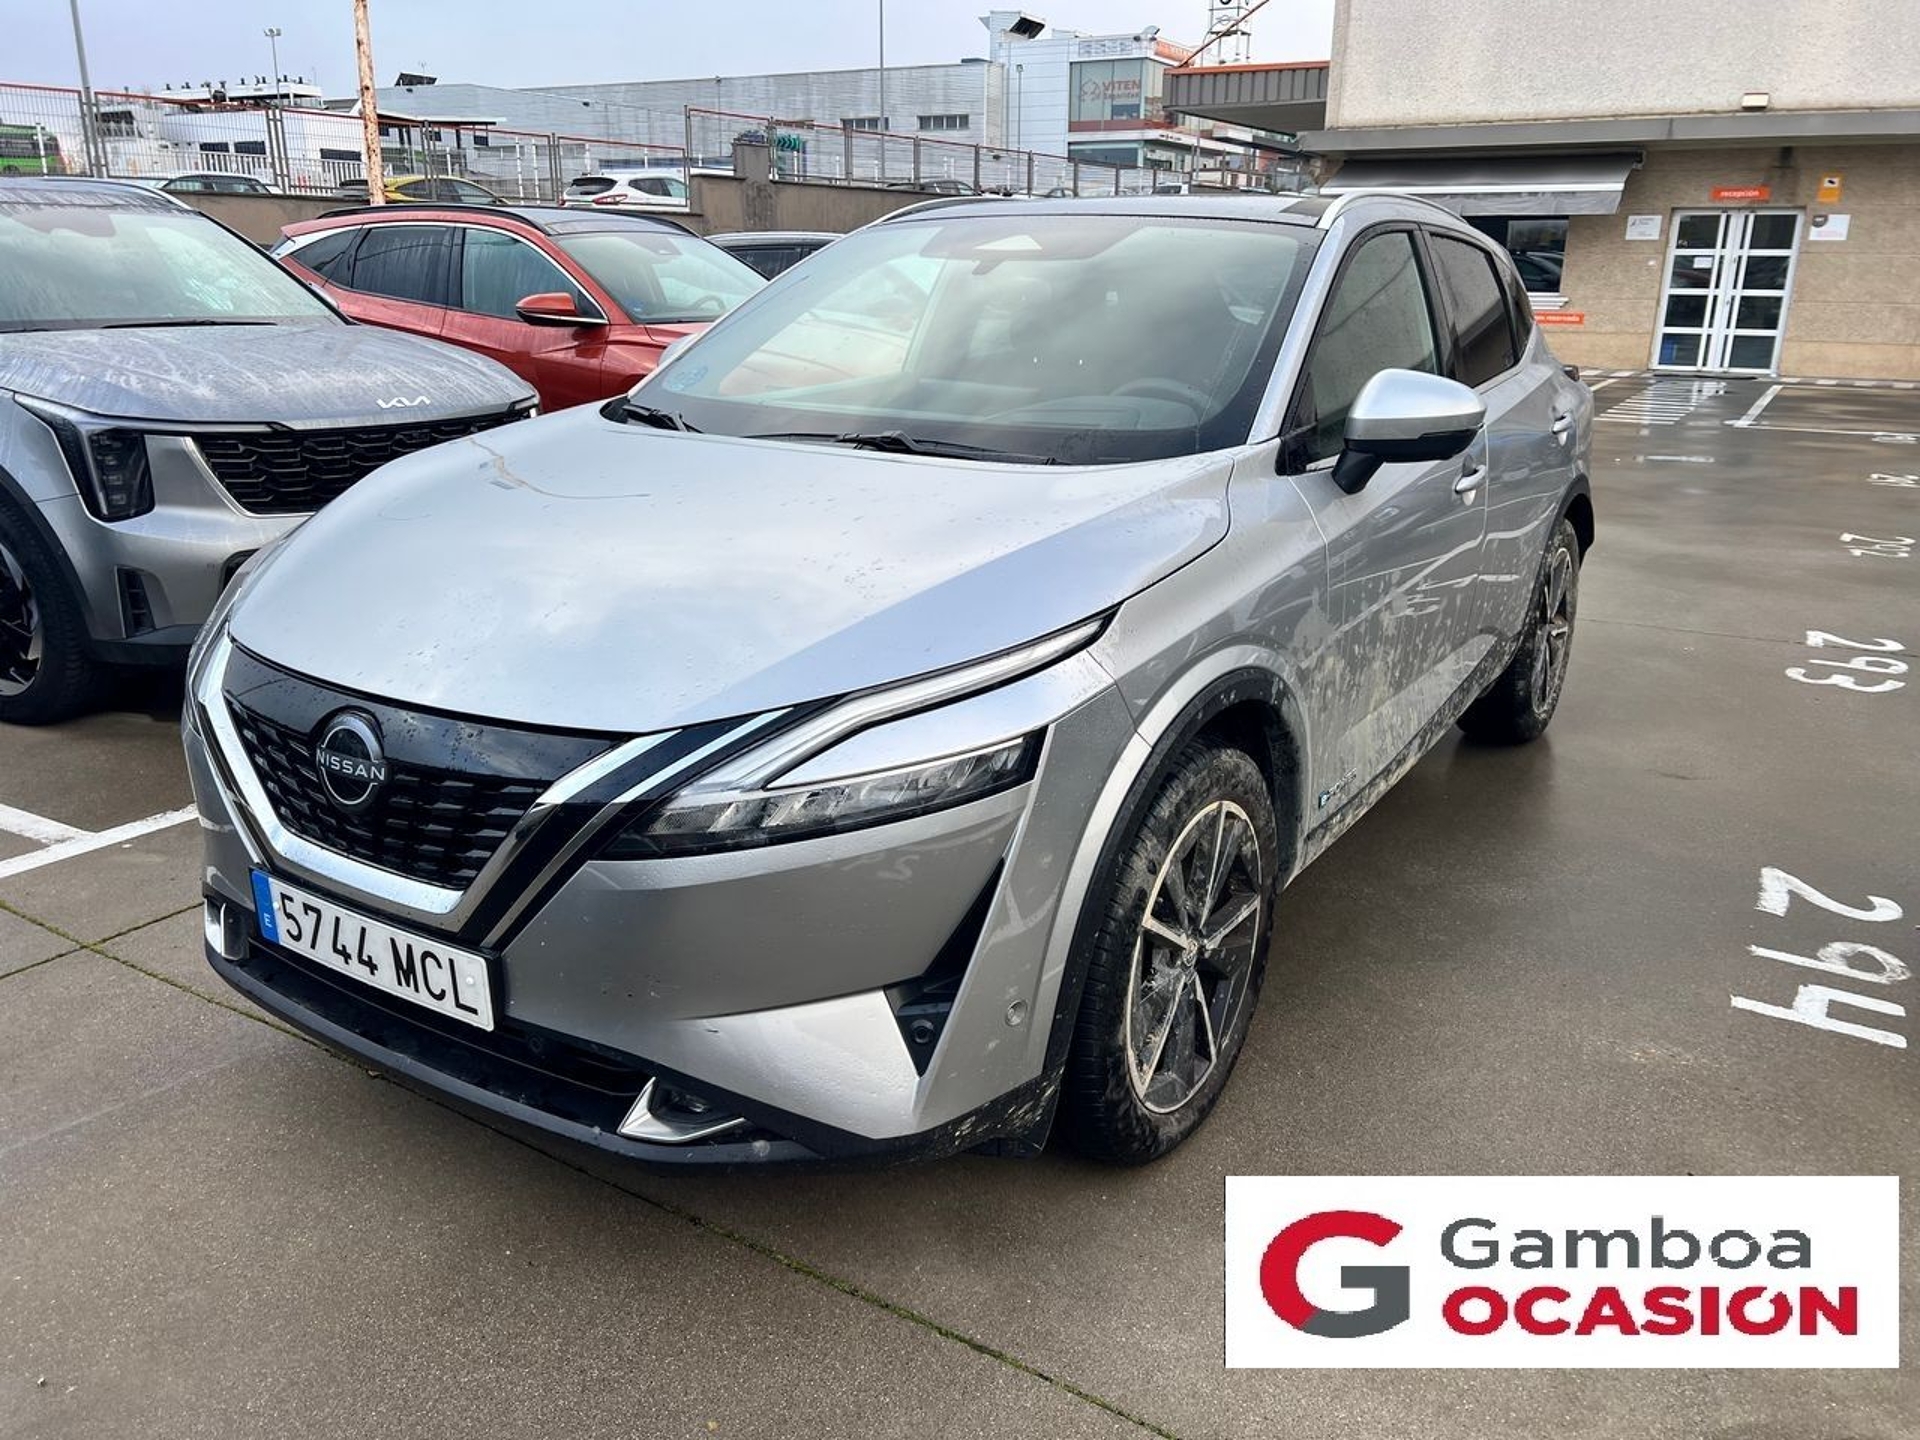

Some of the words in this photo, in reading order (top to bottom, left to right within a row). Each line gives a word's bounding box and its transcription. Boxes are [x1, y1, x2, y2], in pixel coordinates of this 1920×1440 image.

[1785, 630, 1909, 692] 293
[316, 748, 385, 781] NISSAN
[279, 892, 379, 976] 5744
[390, 937, 479, 1016] MCL
[1729, 866, 1912, 1049] 294
